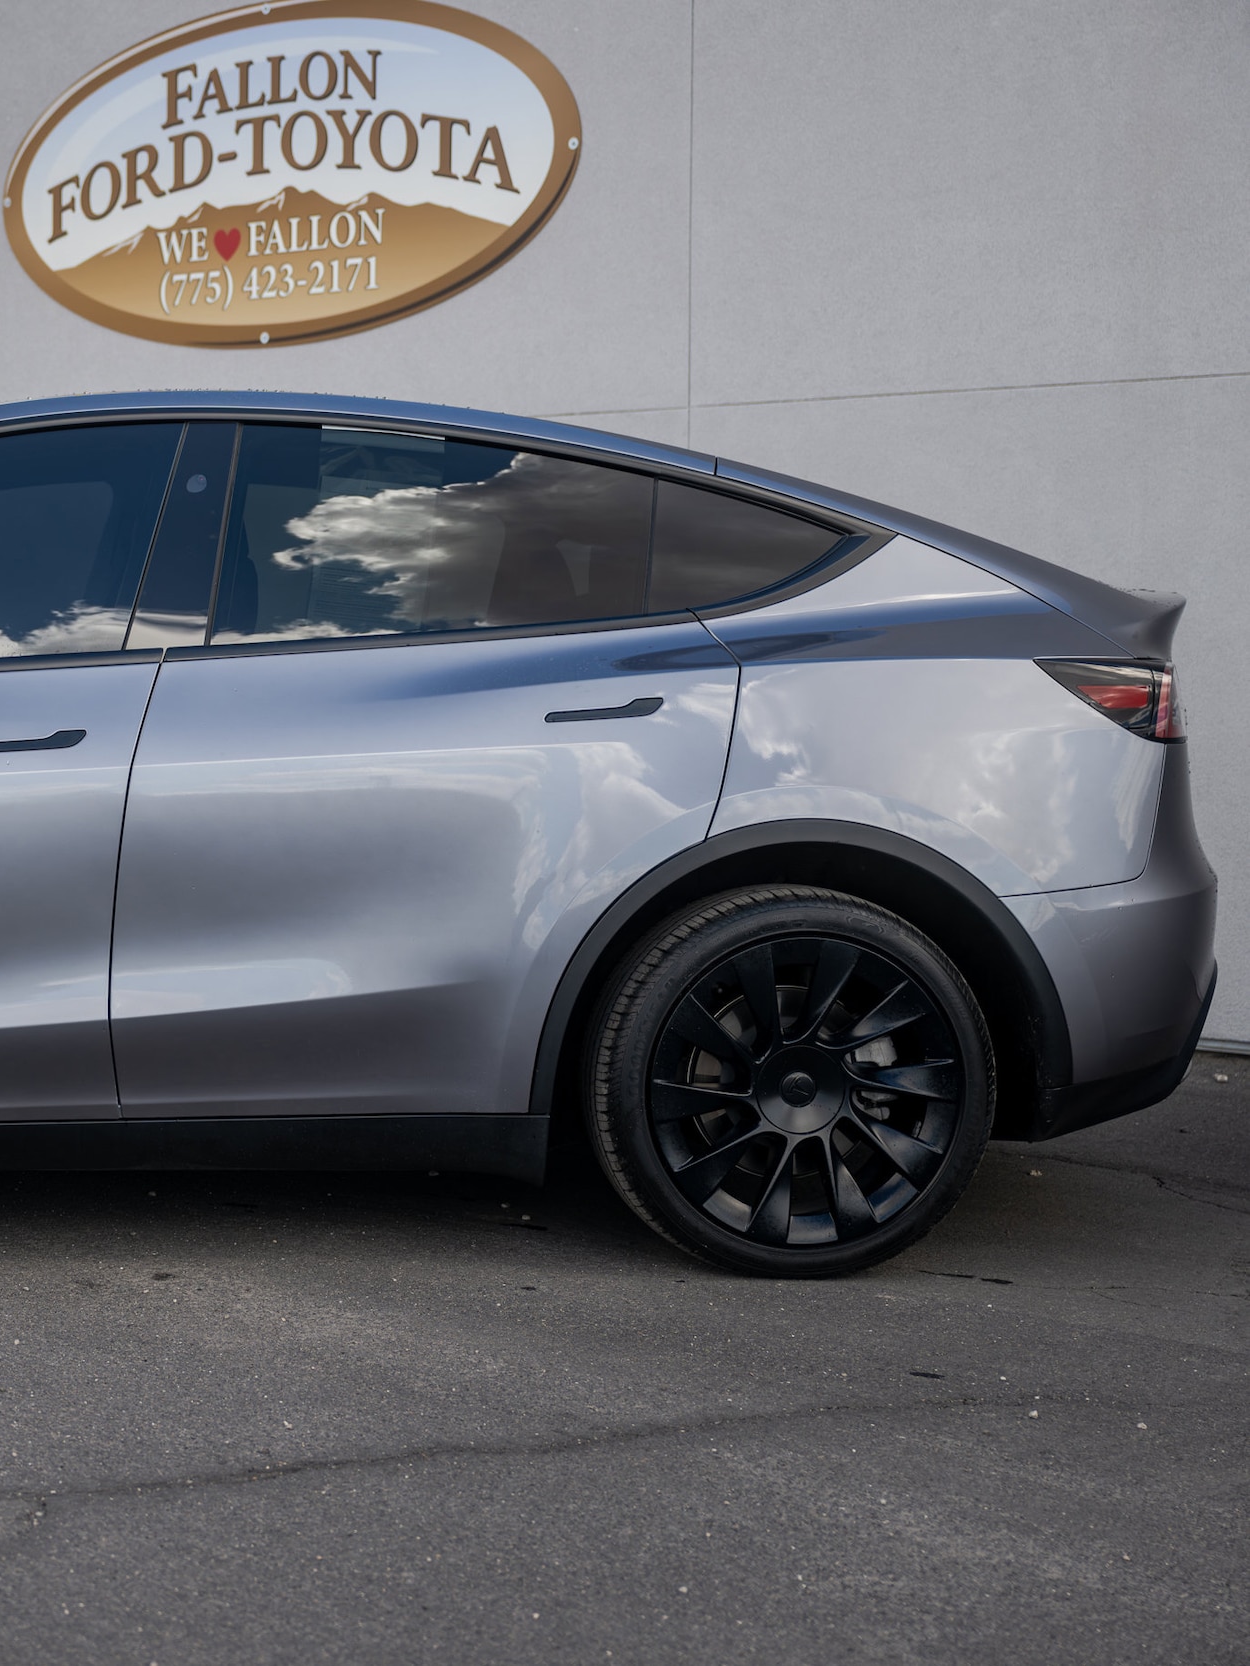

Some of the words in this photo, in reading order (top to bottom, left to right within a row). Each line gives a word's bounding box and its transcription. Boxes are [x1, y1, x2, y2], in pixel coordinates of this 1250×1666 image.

[161, 49, 382, 130] FALLON
[47, 109, 521, 244] FORD-TOYOTA
[156, 226, 210, 266] WE
[247, 208, 387, 257] FALLON
[159, 265, 235, 315] (775)
[242, 256, 381, 302] 423-2171
